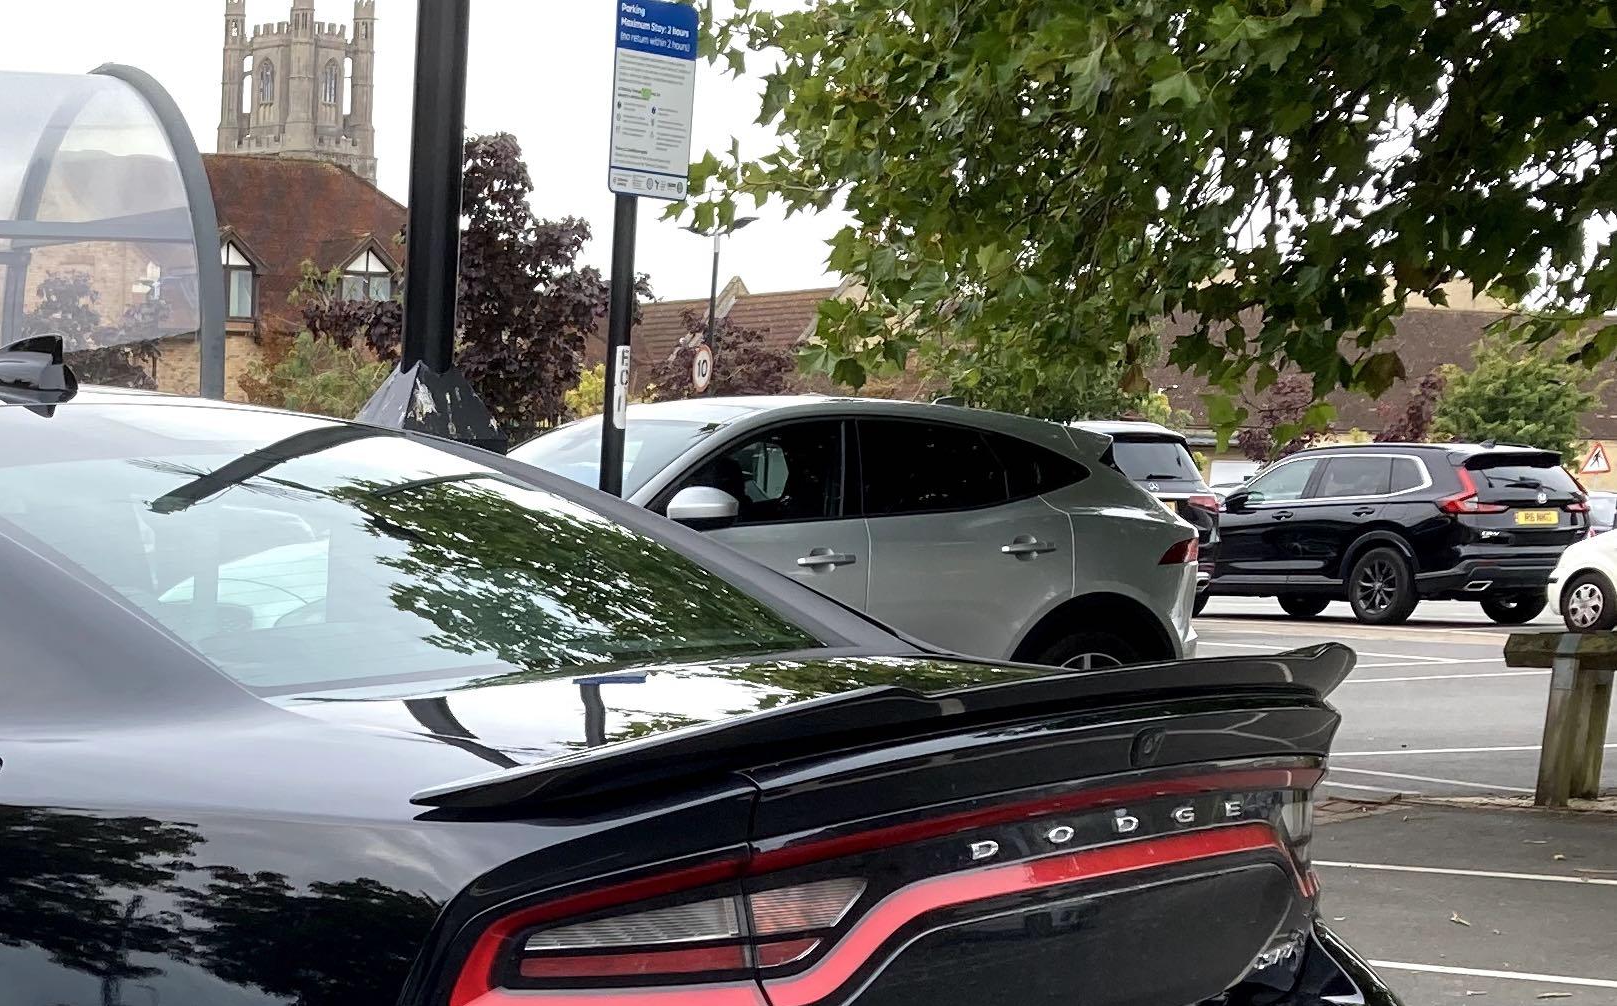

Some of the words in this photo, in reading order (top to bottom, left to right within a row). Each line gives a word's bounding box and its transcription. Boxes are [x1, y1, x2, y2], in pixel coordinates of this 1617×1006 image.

[621, 2, 646, 18] Parking
[620, 17, 651, 31] Maximum
[651, 22, 667, 35] Stay:
[672, 26, 690, 39] hours
[631, 34, 649, 45] return
[649, 37, 667, 47] within
[697, 359, 708, 378] 10
[970, 800, 1242, 861] DODGE
